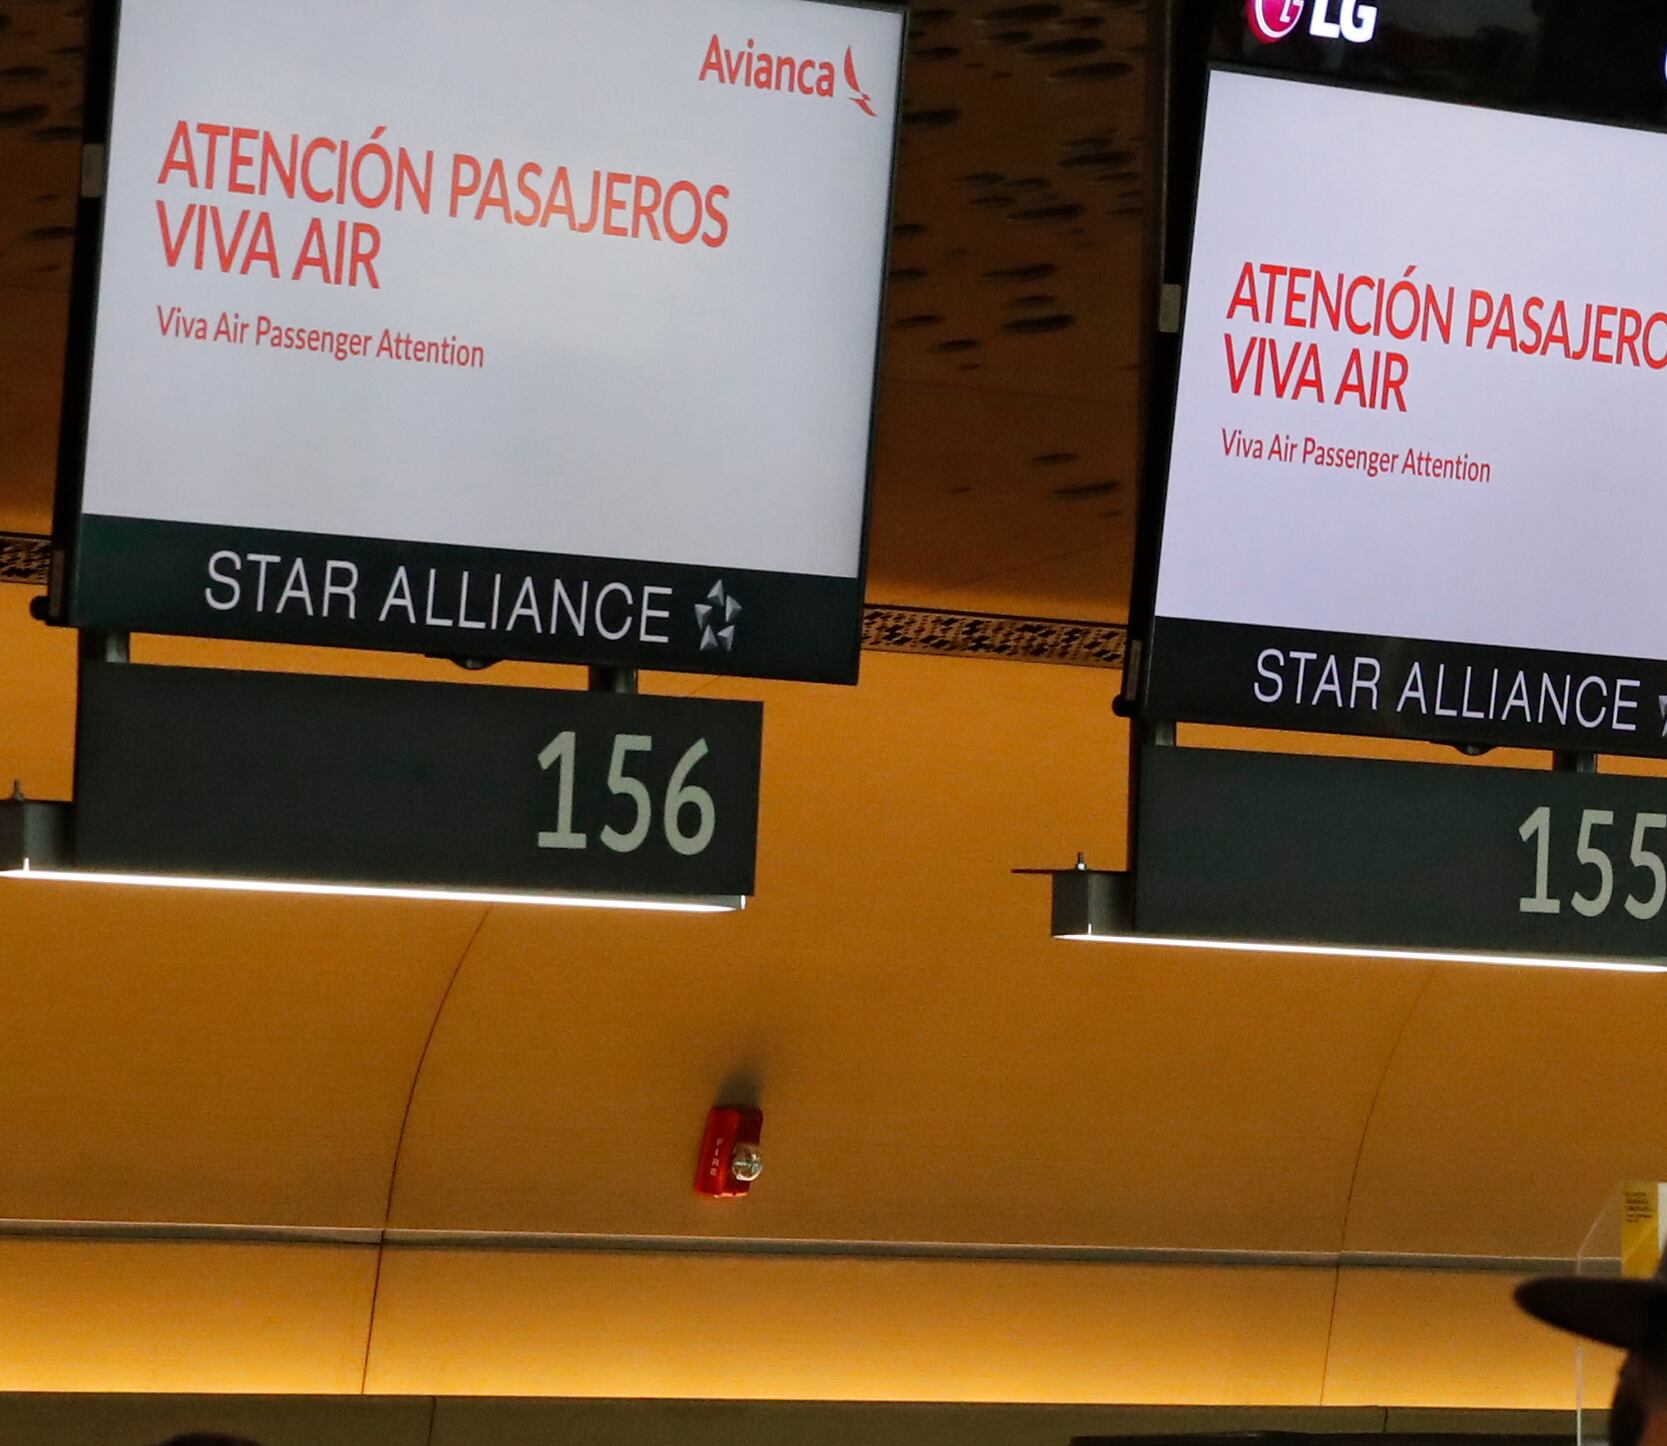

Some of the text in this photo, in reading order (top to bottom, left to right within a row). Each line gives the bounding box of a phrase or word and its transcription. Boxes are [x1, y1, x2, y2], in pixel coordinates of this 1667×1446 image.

[1309, 0, 1378, 43] LG
[699, 35, 836, 98] Avianca
[157, 120, 730, 249] ATENCIÓN PASAJEROS
[156, 200, 383, 290] VIVA AIR
[156, 305, 485, 369] Viva Air Passenger Attention
[1225, 262, 1456, 346] ATENCIÓN
[1223, 333, 1410, 413] VIVA AIR
[1221, 428, 1492, 484] Viva Air Passenger Attention
[204, 550, 674, 644] STAR ALLIANCE
[1253, 649, 1641, 734] STAR ALLIANCE
[536, 731, 718, 856] 156
